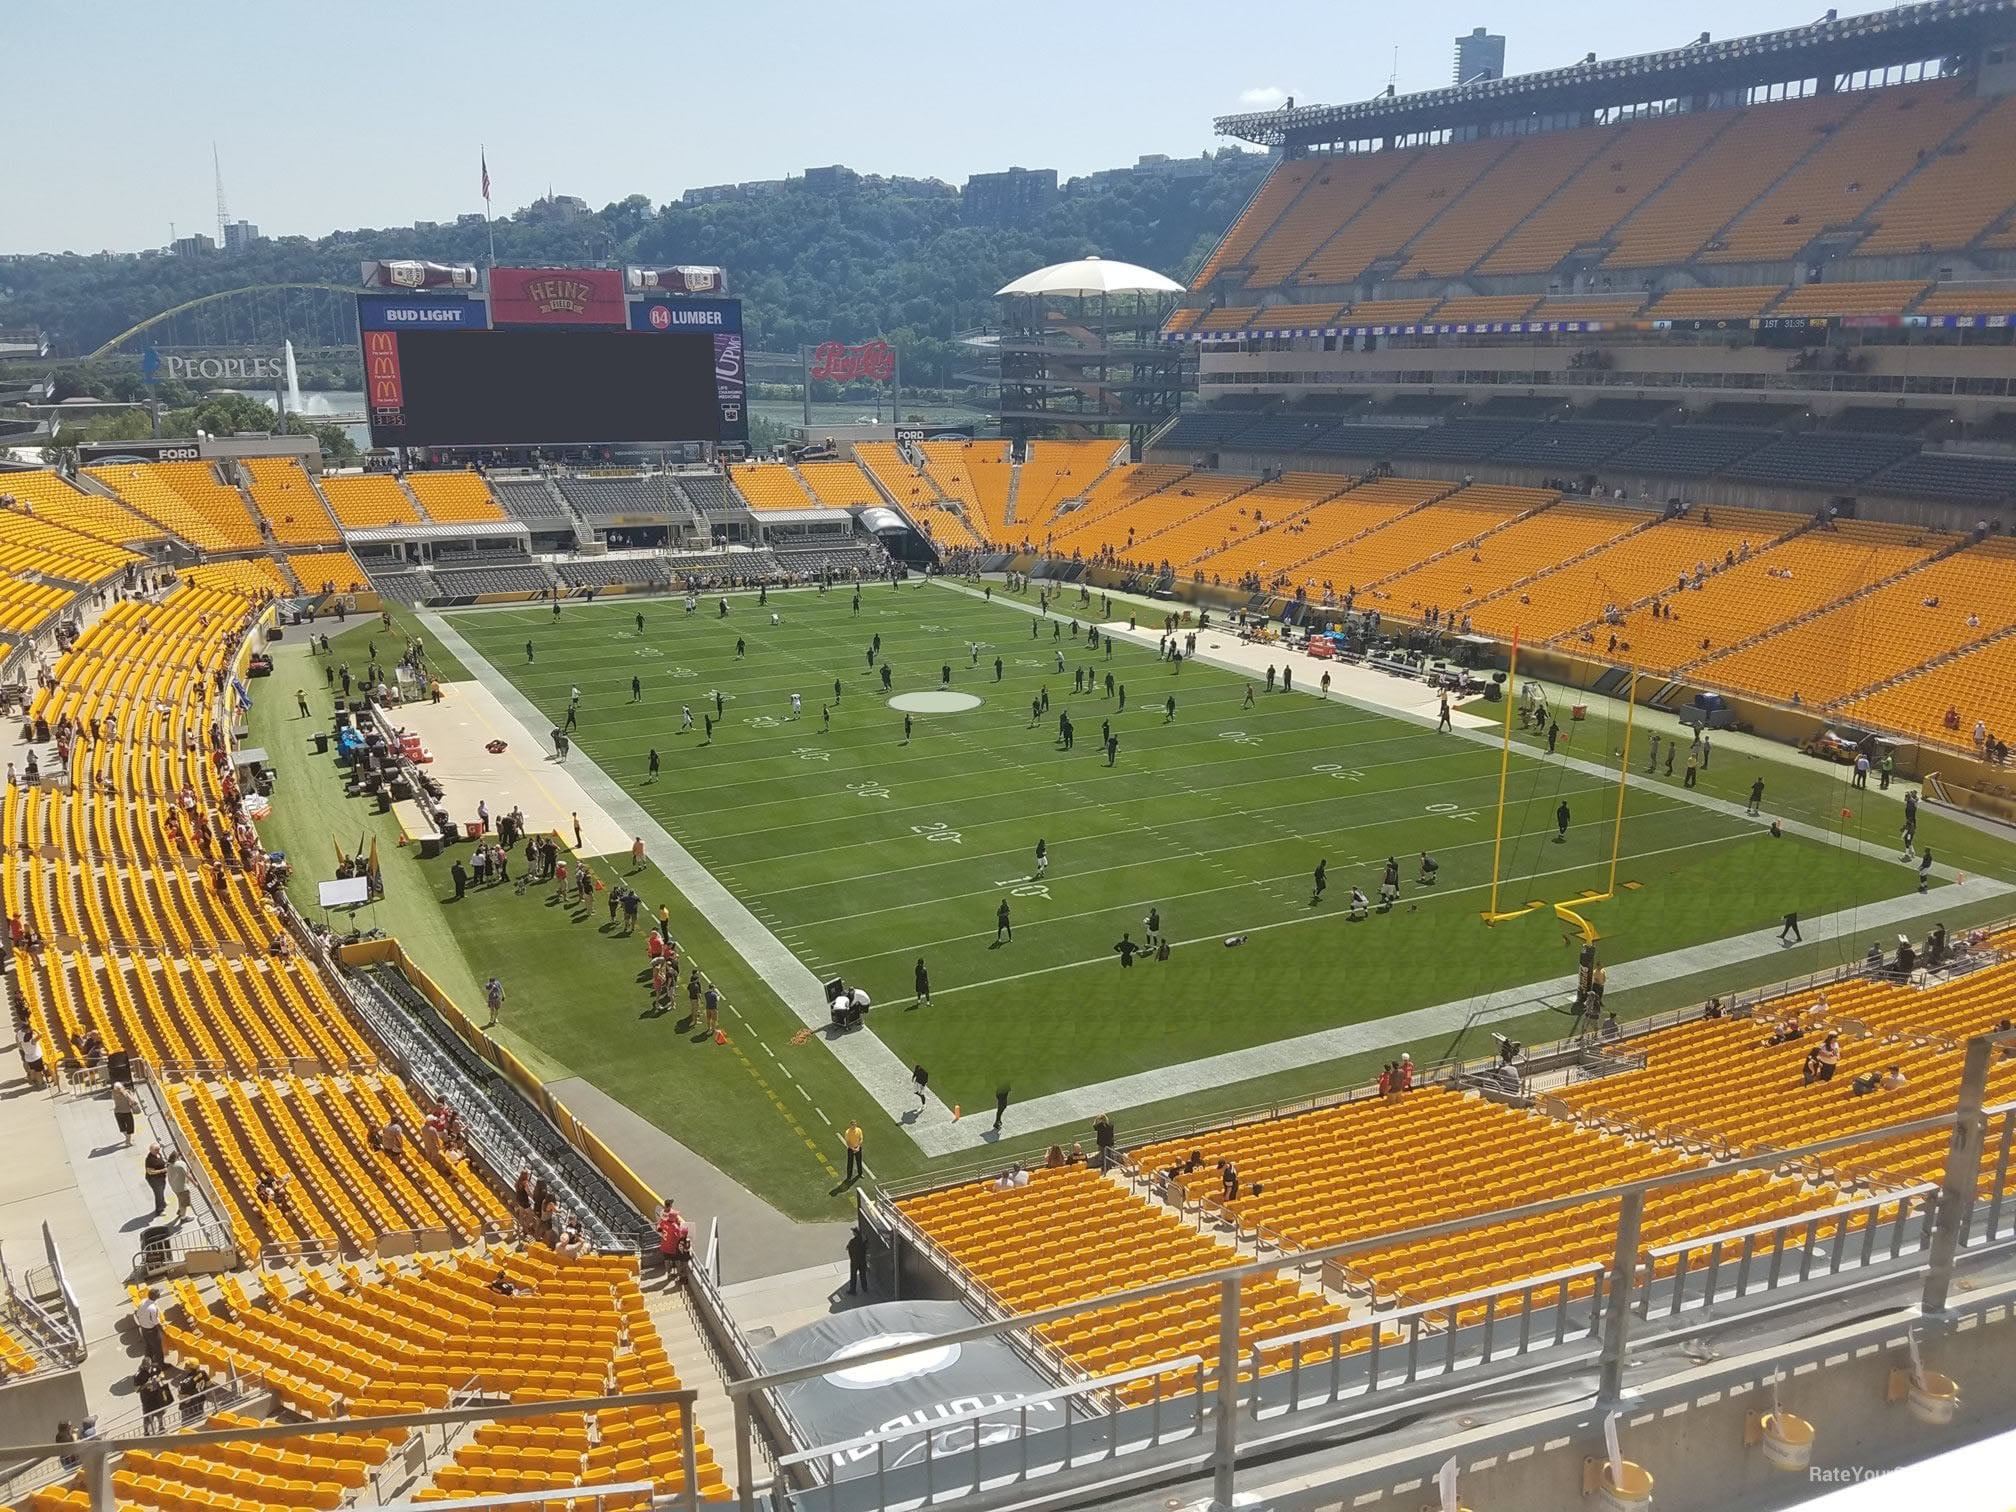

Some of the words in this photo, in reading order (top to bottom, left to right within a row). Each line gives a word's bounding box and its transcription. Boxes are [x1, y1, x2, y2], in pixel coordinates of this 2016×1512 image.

[529, 280, 590, 302] HEINZ
[386, 309, 418, 321] BUD
[420, 309, 462, 321] LIGHT
[652, 310, 668, 325] 84
[672, 310, 722, 325] LUMBER
[716, 335, 741, 376] UPMC
[166, 356, 283, 379] PEOPLES
[896, 431, 924, 440] FORD
[159, 449, 198, 460] FORD
[1311, 764, 1365, 780] 20
[846, 781, 890, 797] 30
[1425, 803, 1480, 820] 10
[910, 822, 962, 841] 20
[994, 875, 1050, 897] 10
